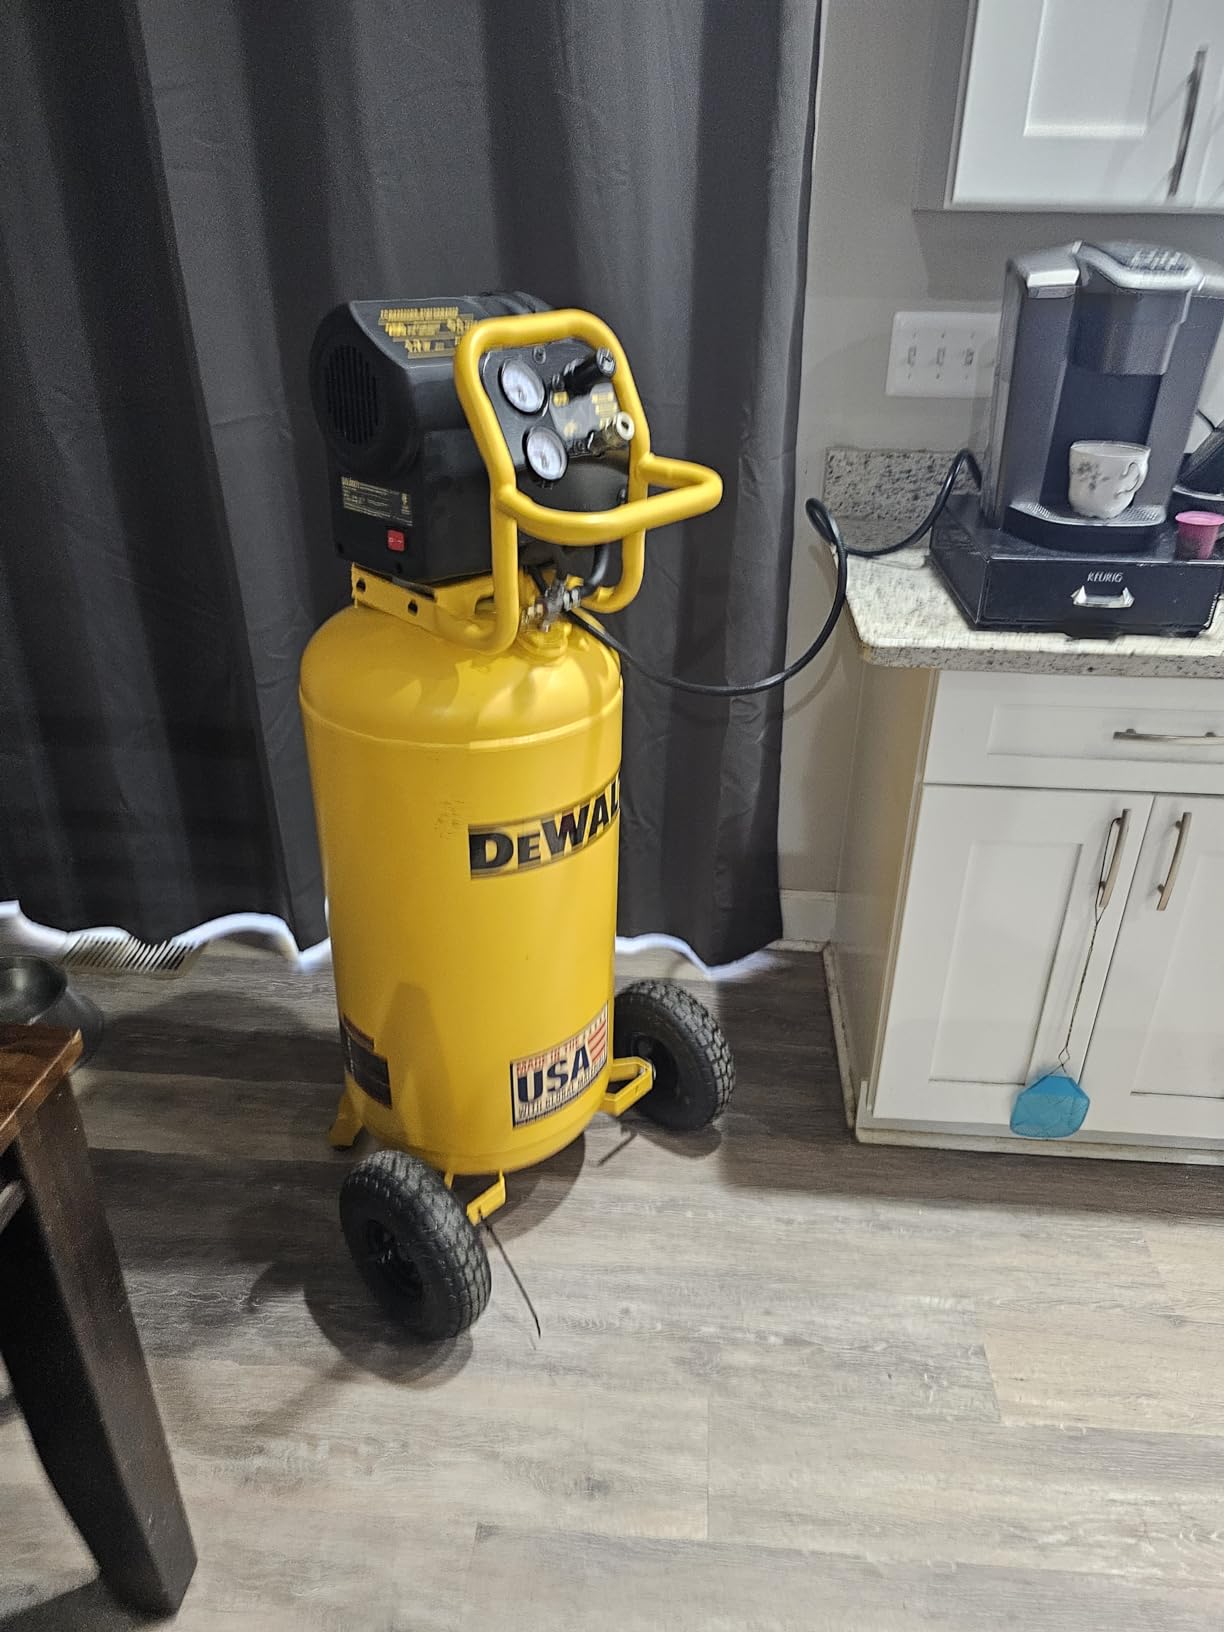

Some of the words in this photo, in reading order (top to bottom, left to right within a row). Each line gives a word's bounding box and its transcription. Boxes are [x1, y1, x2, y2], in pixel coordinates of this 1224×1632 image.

[1087, 571, 1124, 583] KEURIG
[469, 772, 620, 870] DEWAL
[517, 1044, 590, 1103] USA
